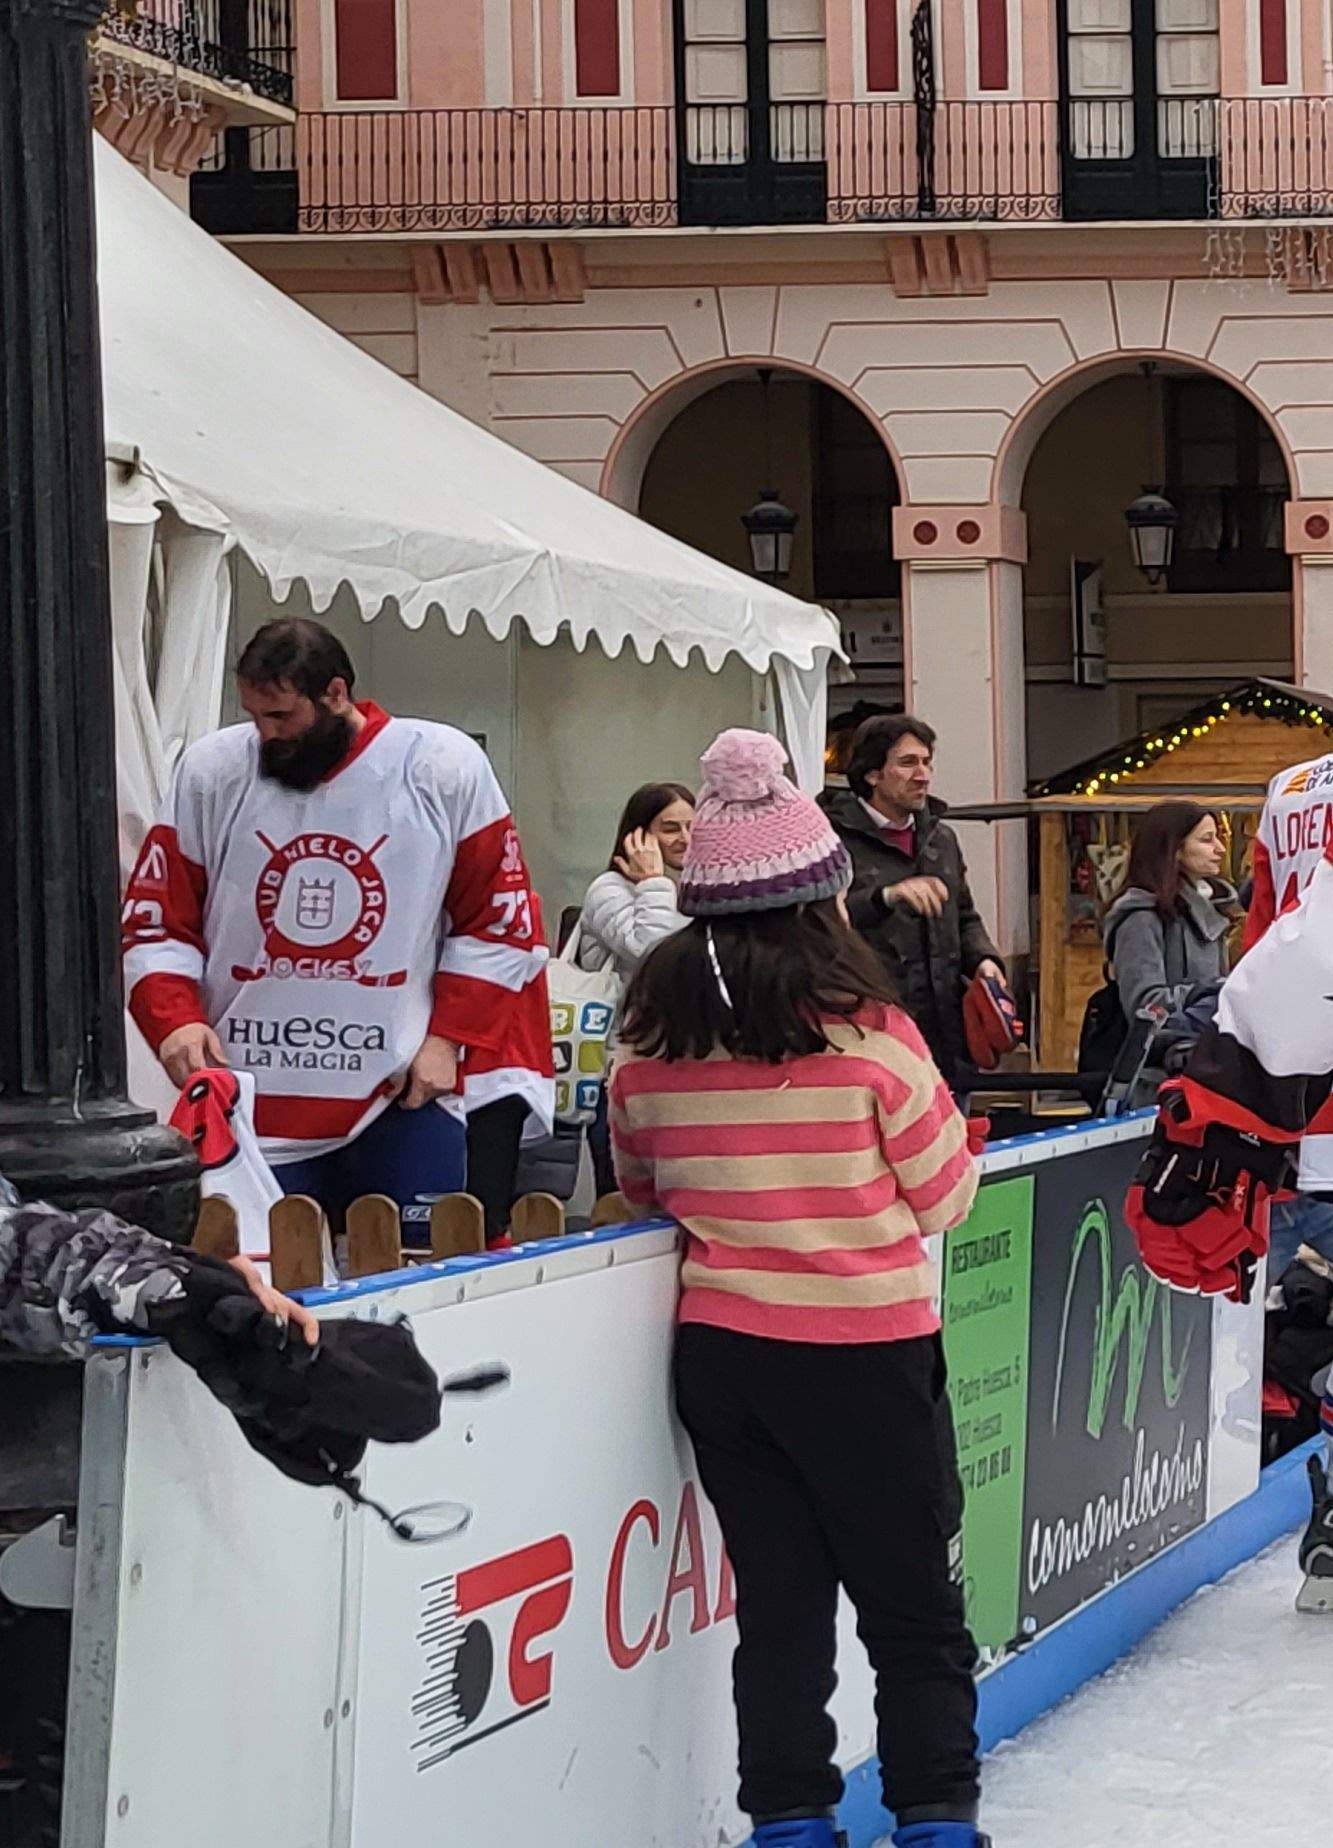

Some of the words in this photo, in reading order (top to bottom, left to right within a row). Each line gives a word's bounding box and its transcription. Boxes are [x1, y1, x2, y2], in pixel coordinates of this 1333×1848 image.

[259, 869, 282, 934] LUB
[354, 876, 383, 943] JACA
[228, 1016, 386, 1051] Huesca
